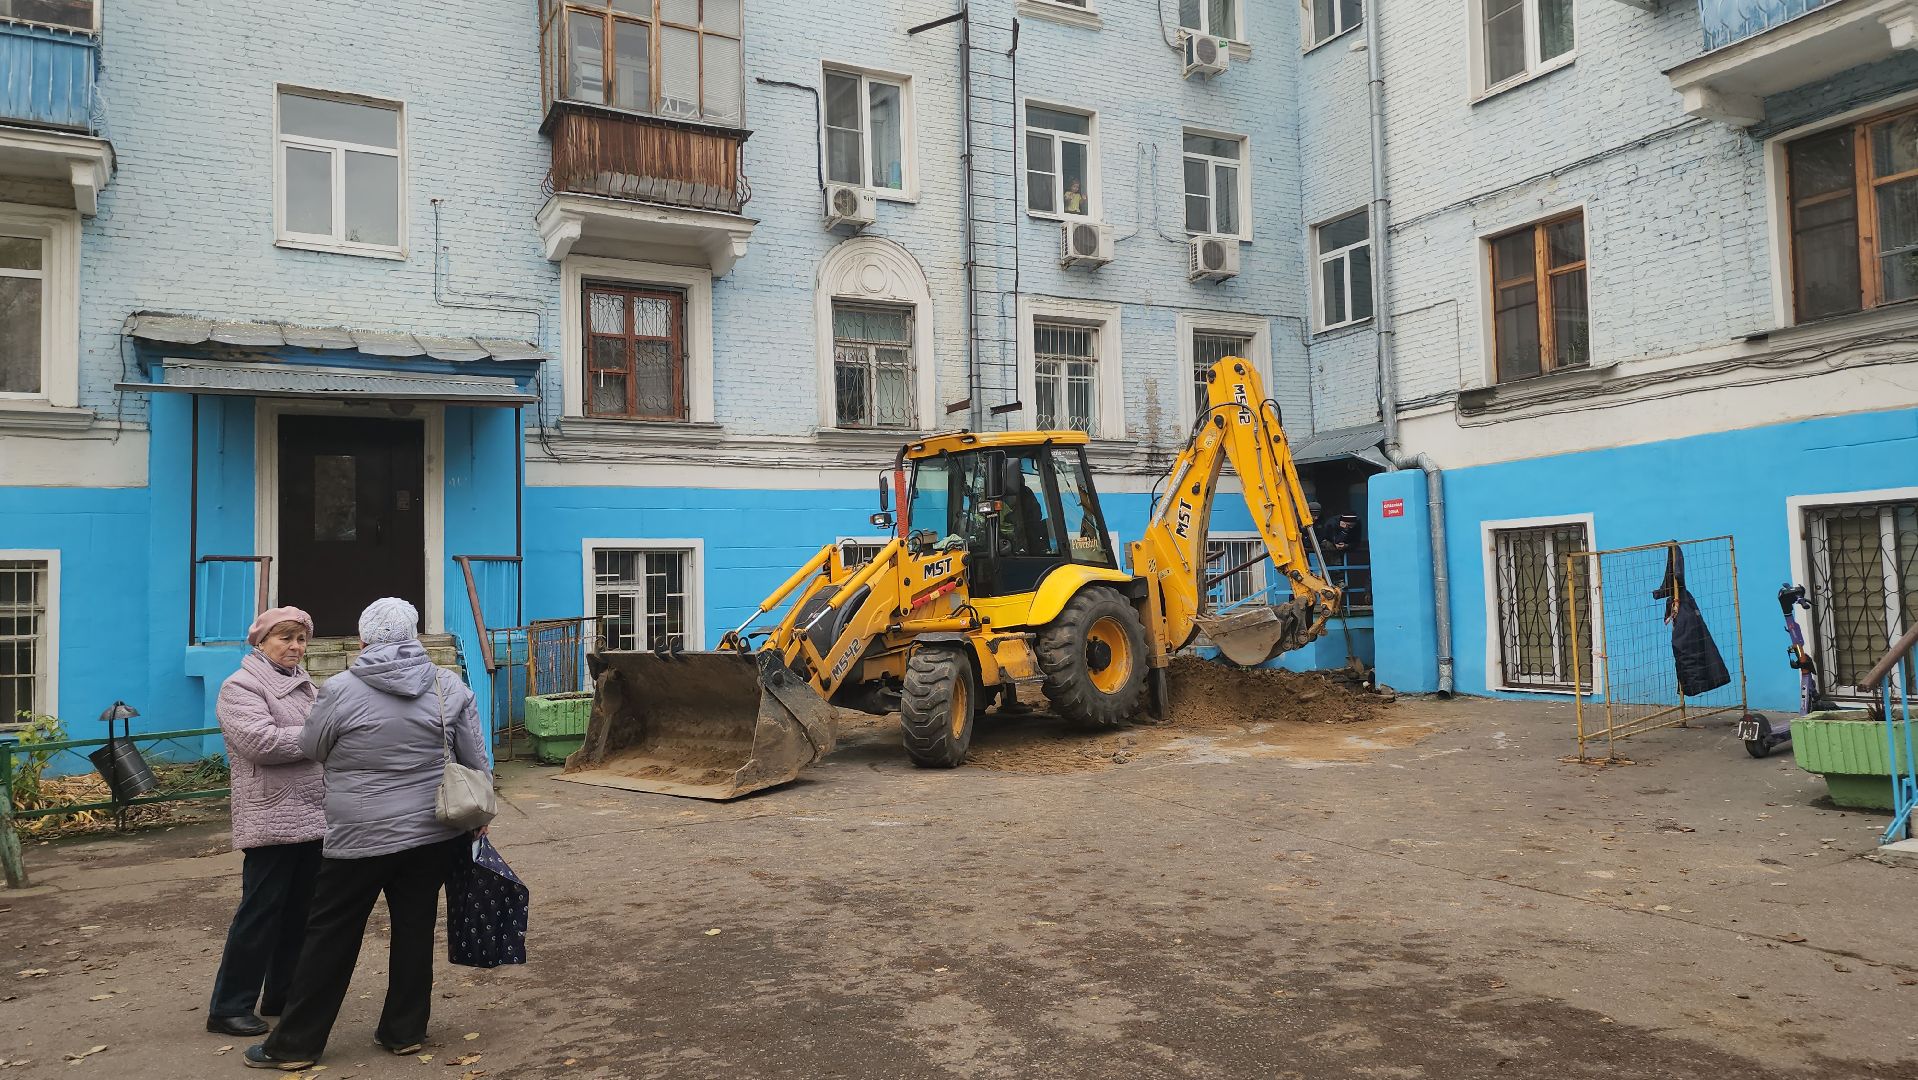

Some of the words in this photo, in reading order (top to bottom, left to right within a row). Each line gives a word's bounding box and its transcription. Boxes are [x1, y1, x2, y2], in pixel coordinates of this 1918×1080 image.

[1175, 497, 1192, 540] MST
[923, 557, 953, 580] MST
[830, 638, 863, 682] M542
